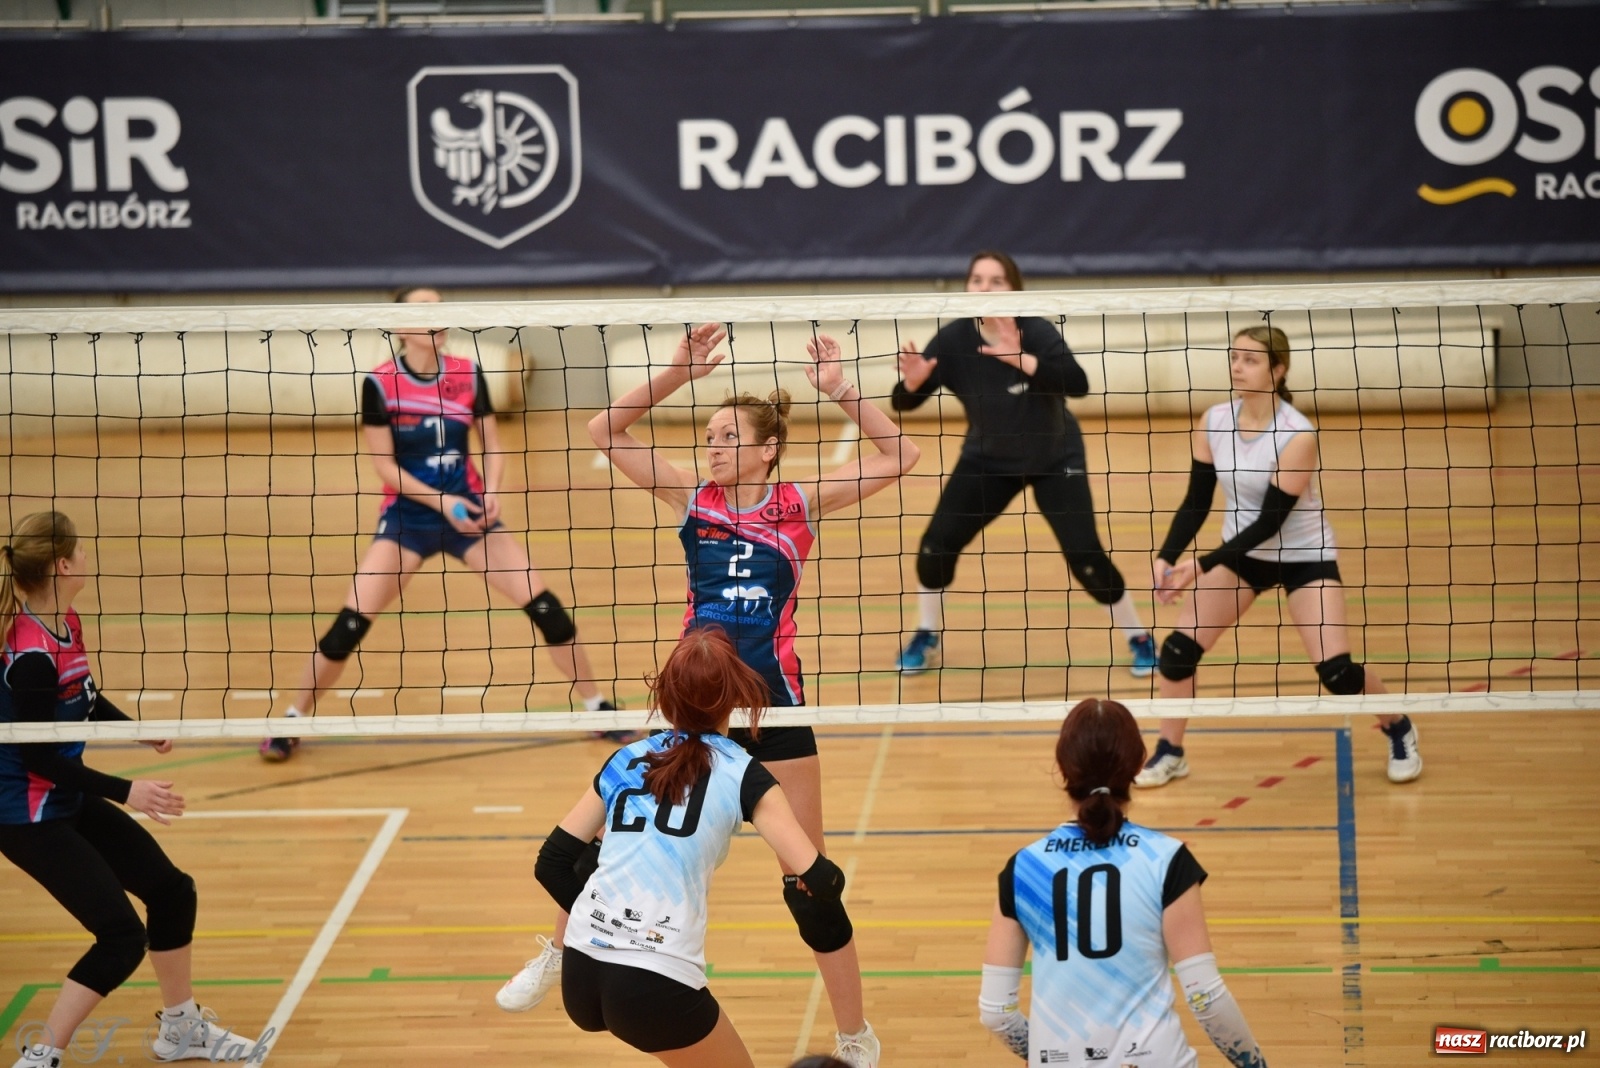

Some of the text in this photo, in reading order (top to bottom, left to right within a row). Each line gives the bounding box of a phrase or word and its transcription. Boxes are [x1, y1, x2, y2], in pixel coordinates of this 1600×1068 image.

[678, 86, 1186, 190] RACIBÓRZ
[17, 192, 192, 230] RACIBÓRZ
[728, 540, 754, 577] 2
[611, 757, 711, 837] 20
[1044, 833, 1140, 852] EMERNG
[1053, 863, 1122, 961] 10
